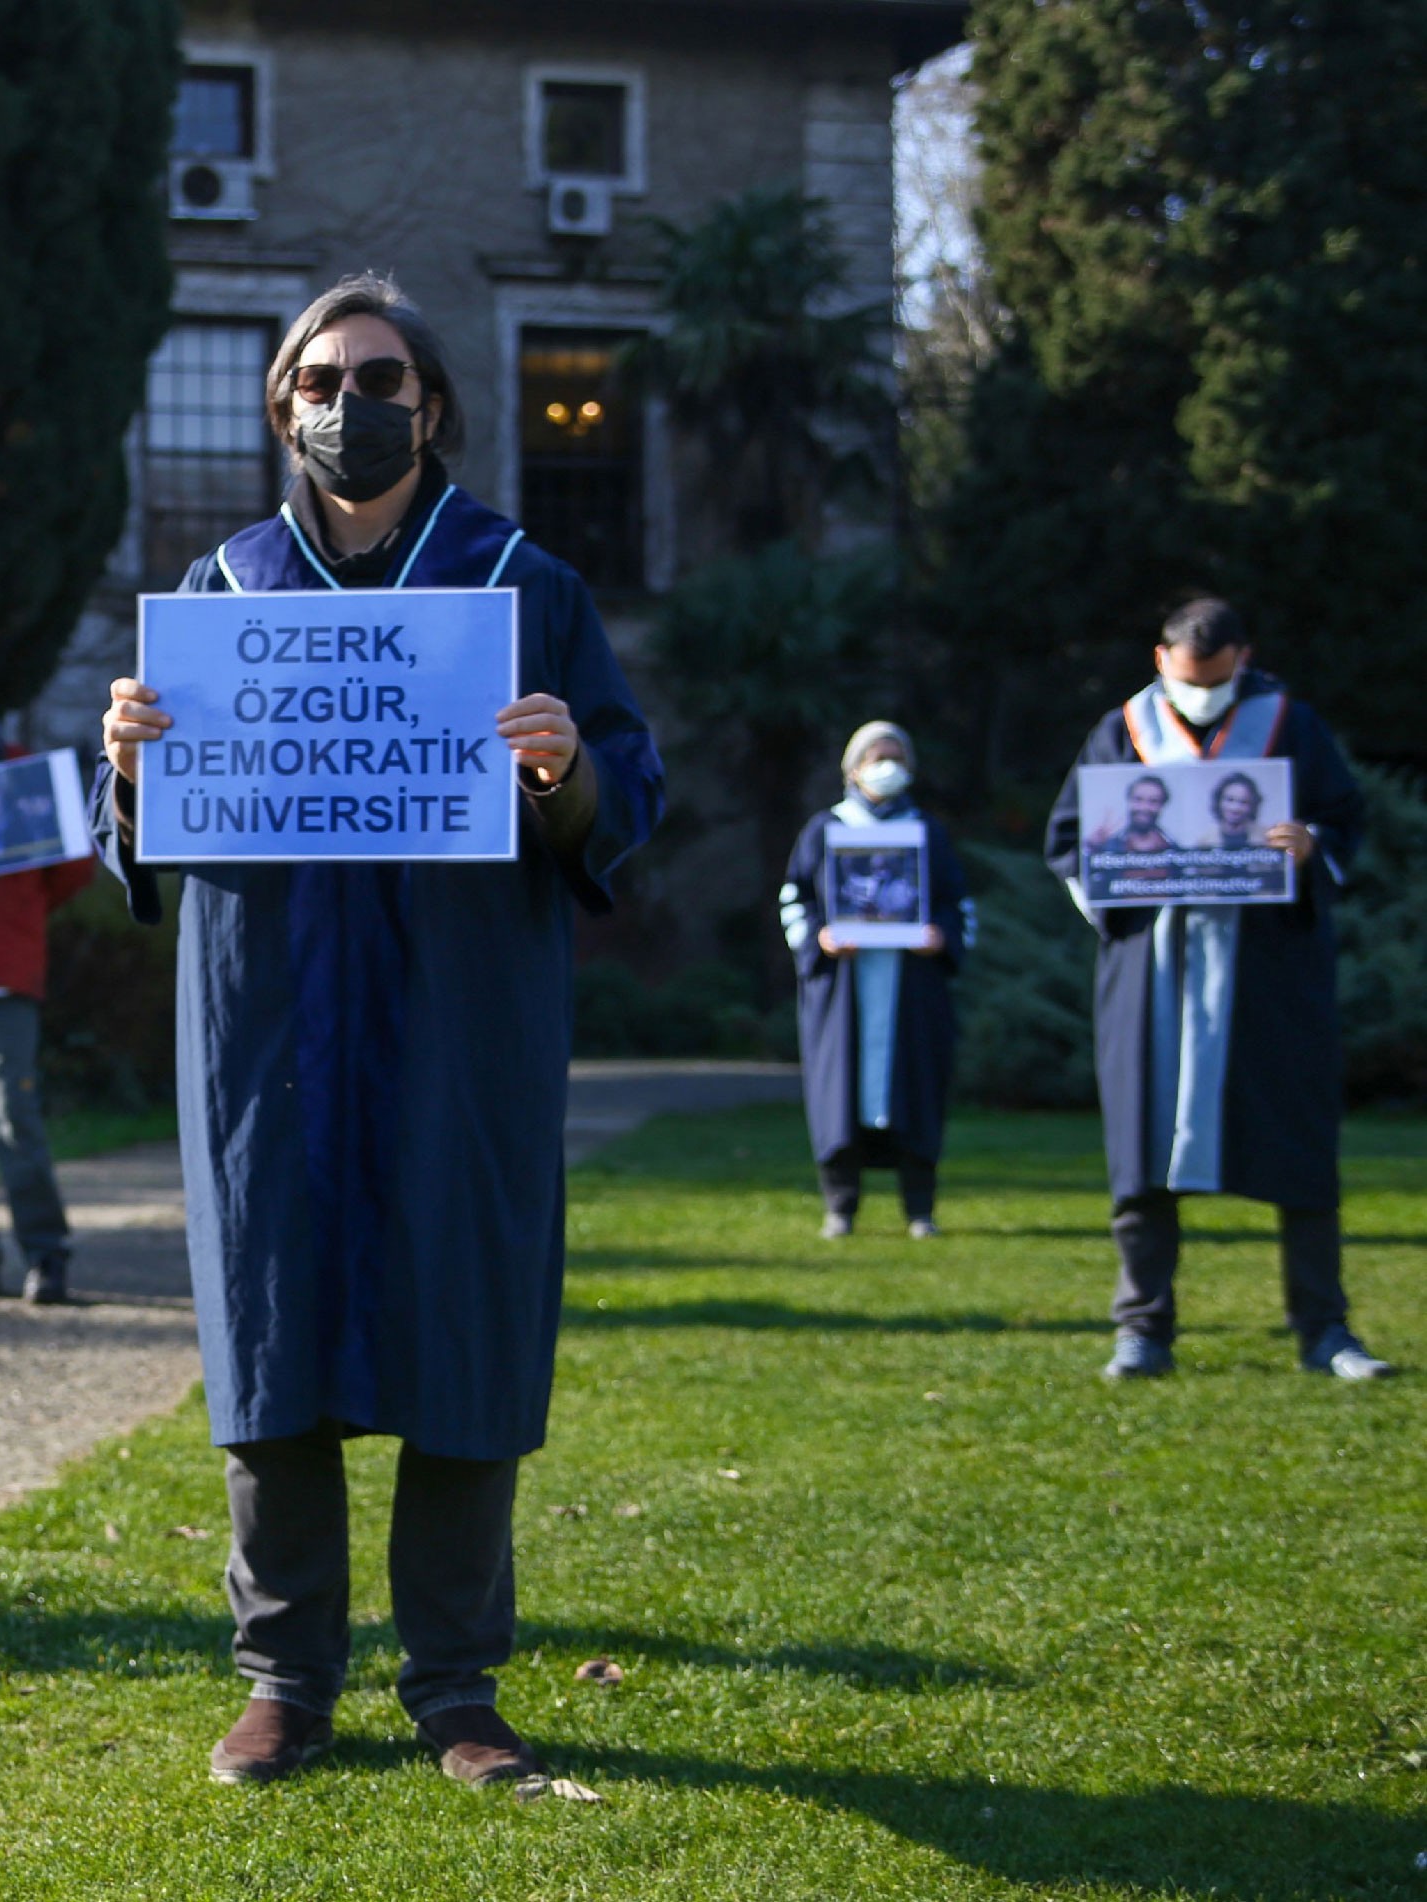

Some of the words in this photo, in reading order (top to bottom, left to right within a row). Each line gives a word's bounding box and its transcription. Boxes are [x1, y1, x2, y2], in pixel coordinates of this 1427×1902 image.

[236, 619, 417, 668] ÖZERK,
[233, 677, 419, 728] ÖZGÜR,
[163, 728, 488, 776] DEMOKRATİK
[181, 787, 471, 833] ÜNİVERSİTE
